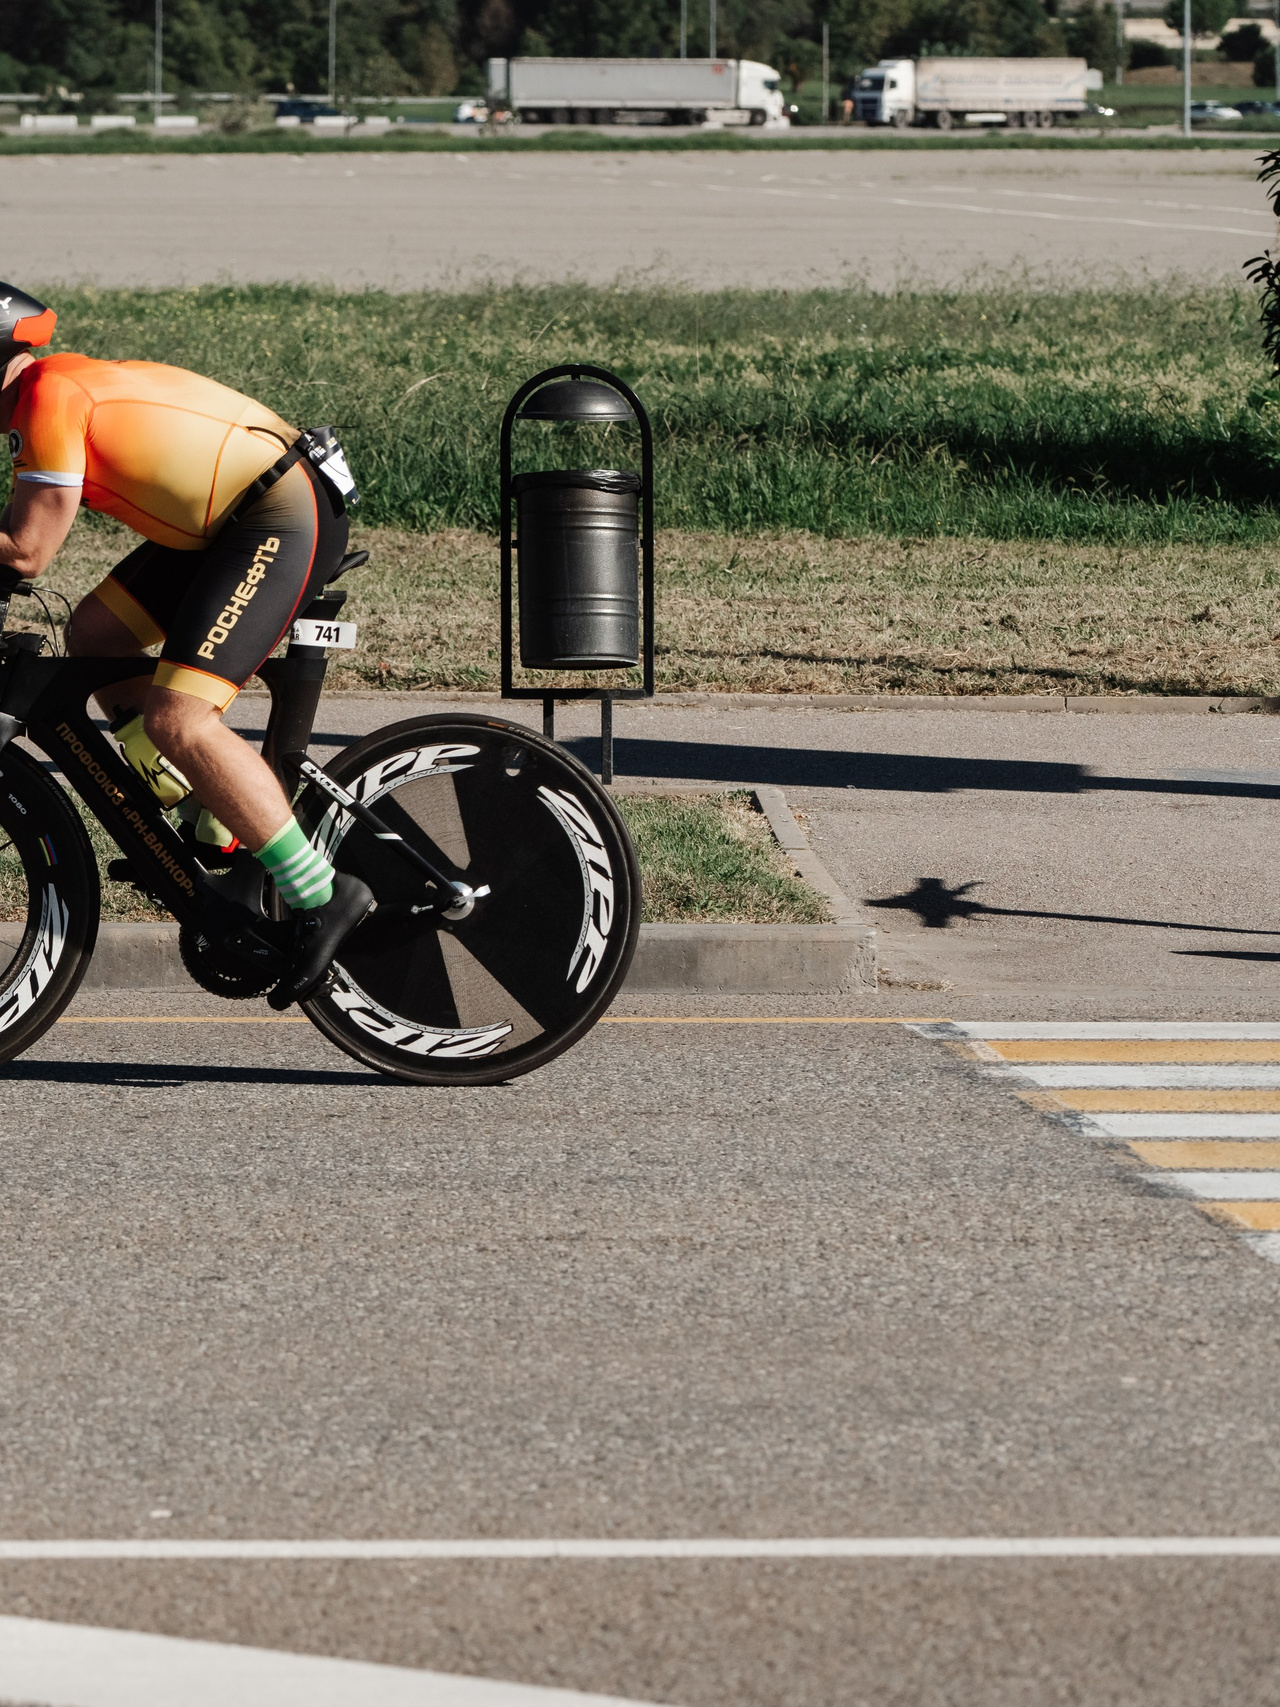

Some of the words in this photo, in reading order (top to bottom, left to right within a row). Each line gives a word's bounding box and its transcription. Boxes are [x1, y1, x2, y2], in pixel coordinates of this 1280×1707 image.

[197, 537, 280, 660] РОСНЕФТЬ
[315, 625, 340, 642] 741
[8, 793, 27, 815] 1080
[56, 722, 125, 806] ПРОФСОЮЗ
[538, 785, 614, 994] ZIPP
